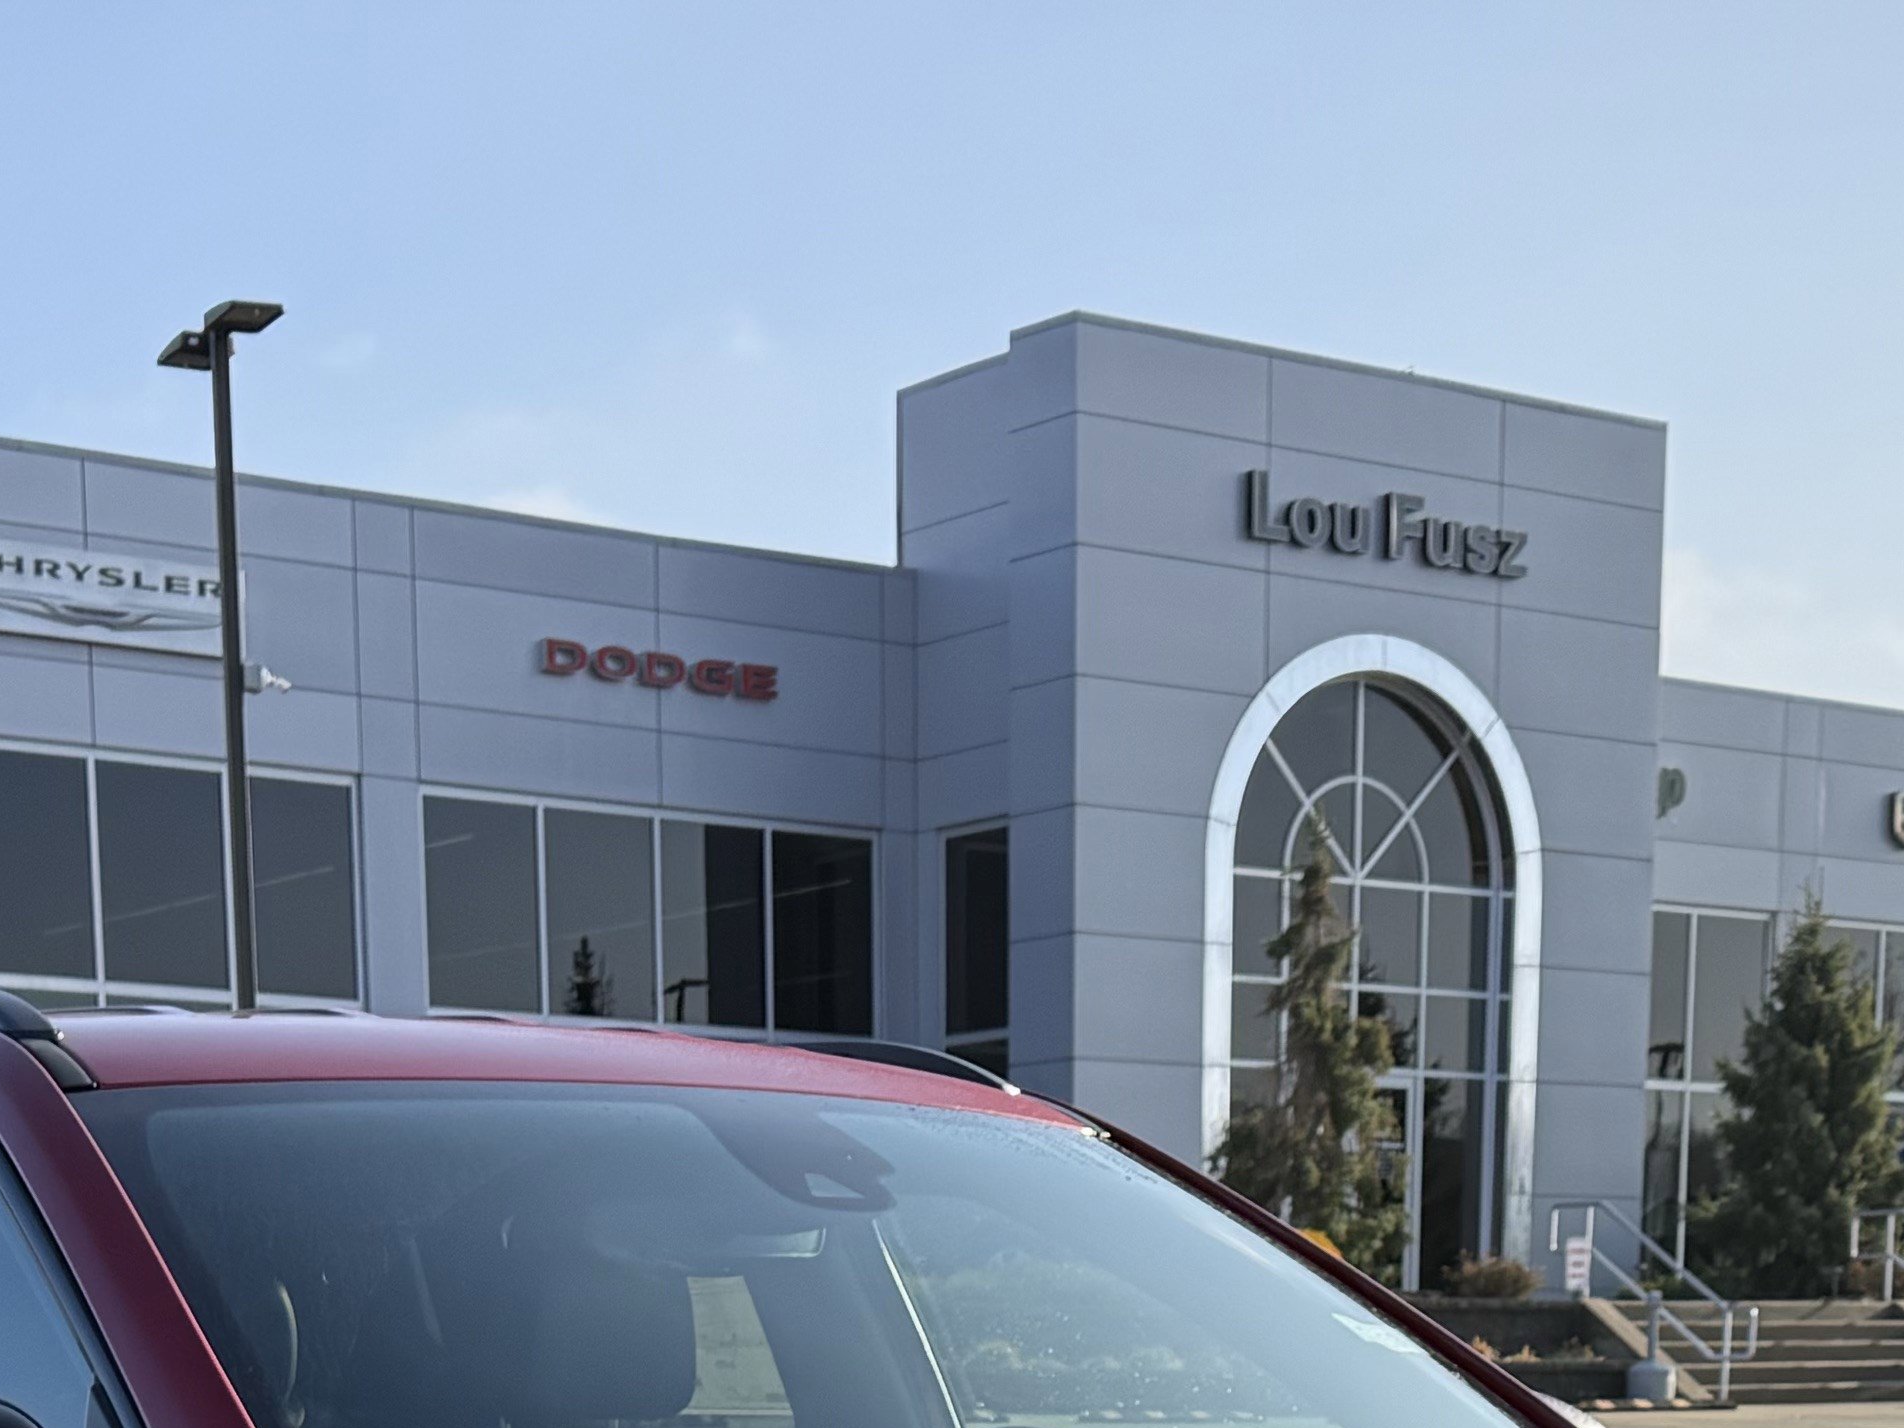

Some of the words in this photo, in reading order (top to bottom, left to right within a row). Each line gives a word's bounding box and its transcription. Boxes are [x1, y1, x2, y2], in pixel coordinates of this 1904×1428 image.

[1242, 469, 1369, 556] Lou
[1380, 491, 1528, 578] Fusz
[539, 637, 779, 702] DODGE
